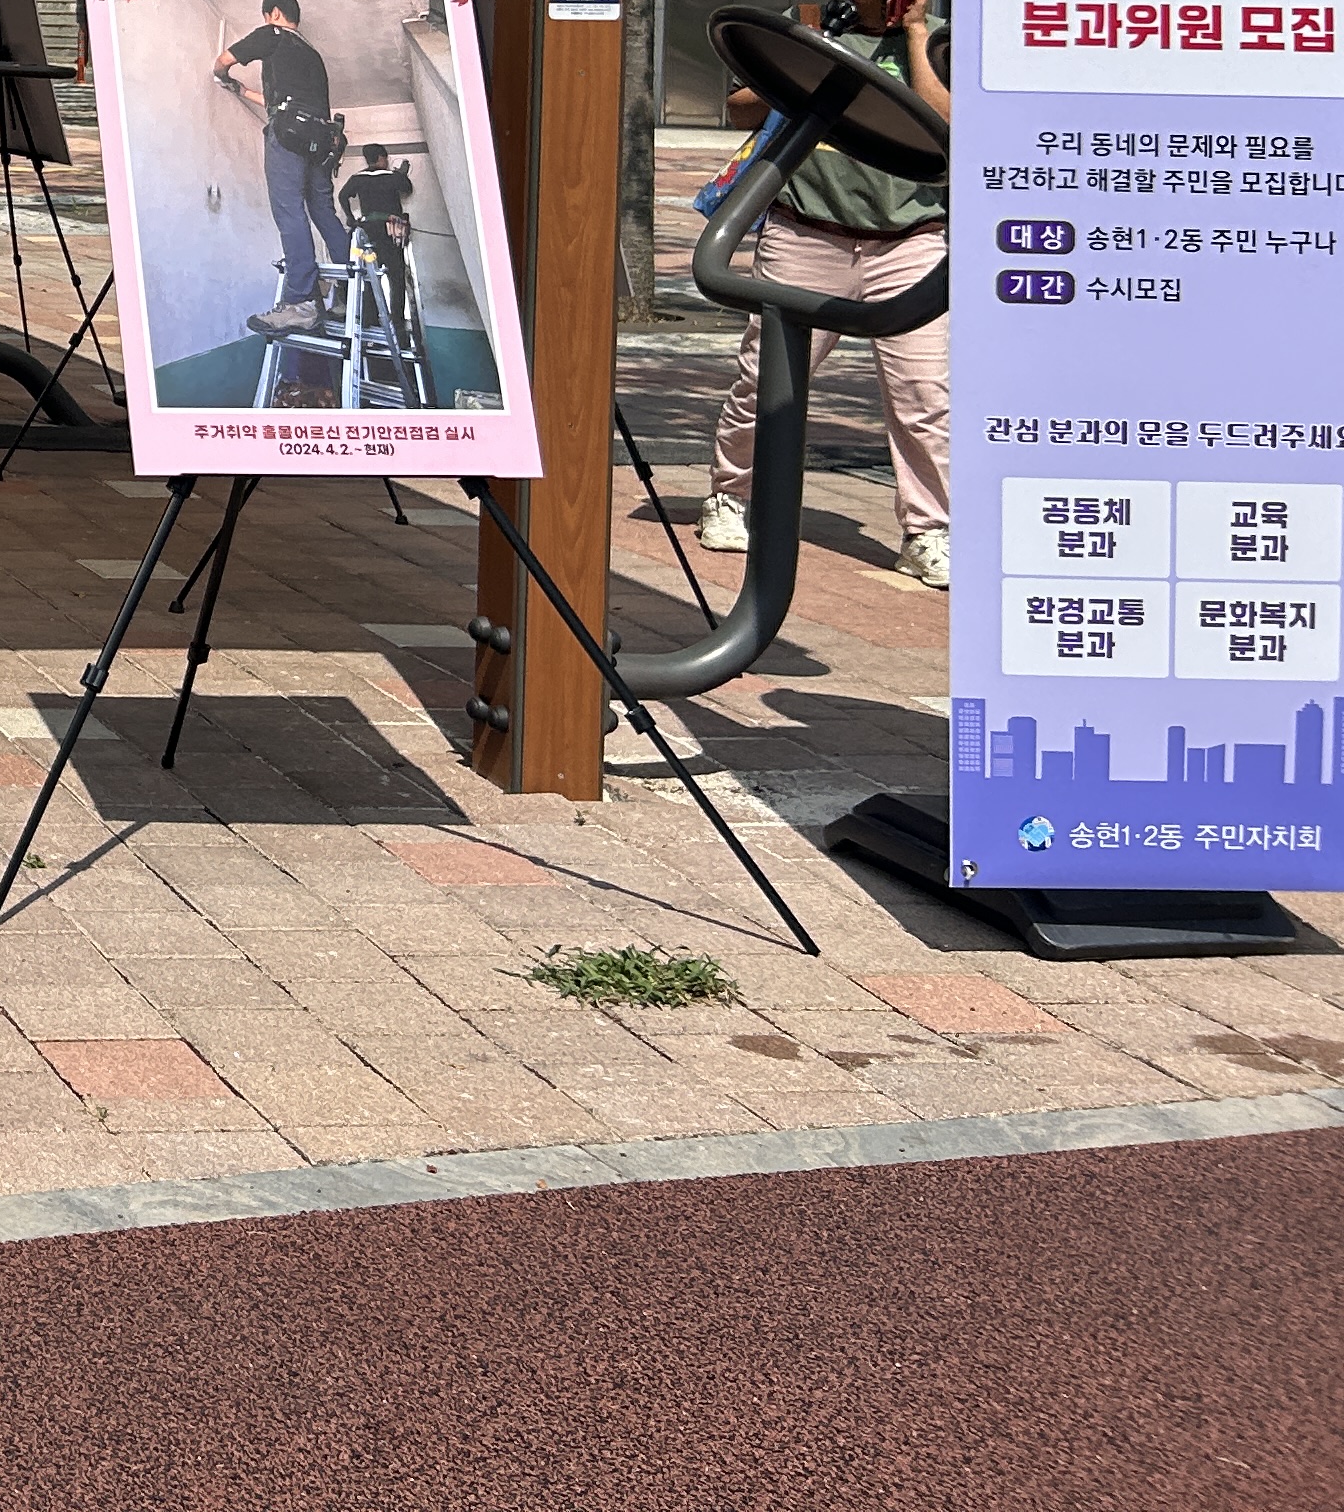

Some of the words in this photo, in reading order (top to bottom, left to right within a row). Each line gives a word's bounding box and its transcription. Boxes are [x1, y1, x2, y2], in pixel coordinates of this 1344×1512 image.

[1022, 1, 1224, 51] 분과위원
[1239, 6, 1335, 53] 모집
[1036, 131, 1082, 156] 우리
[1090, 132, 1160, 158] 동네의
[1167, 134, 1238, 159] 문제와
[1244, 135, 1315, 161] 필요를
[983, 166, 1078, 191] 발견하고
[1086, 169, 1156, 194] 해결할
[1163, 170, 1233, 195] 주민을
[1086, 226, 1203, 254] 송현1·2동
[1211, 229, 1258, 254] 주민
[1265, 229, 1337, 256] 누구나
[1086, 277, 1182, 302] 수시모집
[194, 425, 257, 439] 주거취약
[345, 426, 439, 441] 전기안전점검
[444, 426, 475, 441] 실시
[985, 416, 1039, 443] 관심
[1049, 419, 1128, 446] 분과의
[1137, 420, 1190, 446] 문을
[1042, 497, 1131, 525] 공동체
[1230, 501, 1288, 530] 교육
[1057, 530, 1117, 559] 분과
[1229, 534, 1289, 563] 분과
[1026, 596, 1145, 627] 환경교통
[1198, 600, 1316, 630] 문화복지
[1056, 630, 1115, 659] 분과
[1227, 634, 1287, 663] 분과
[1069, 822, 1184, 851] 송현1·2동
[1194, 824, 1322, 852] 주민자치회
